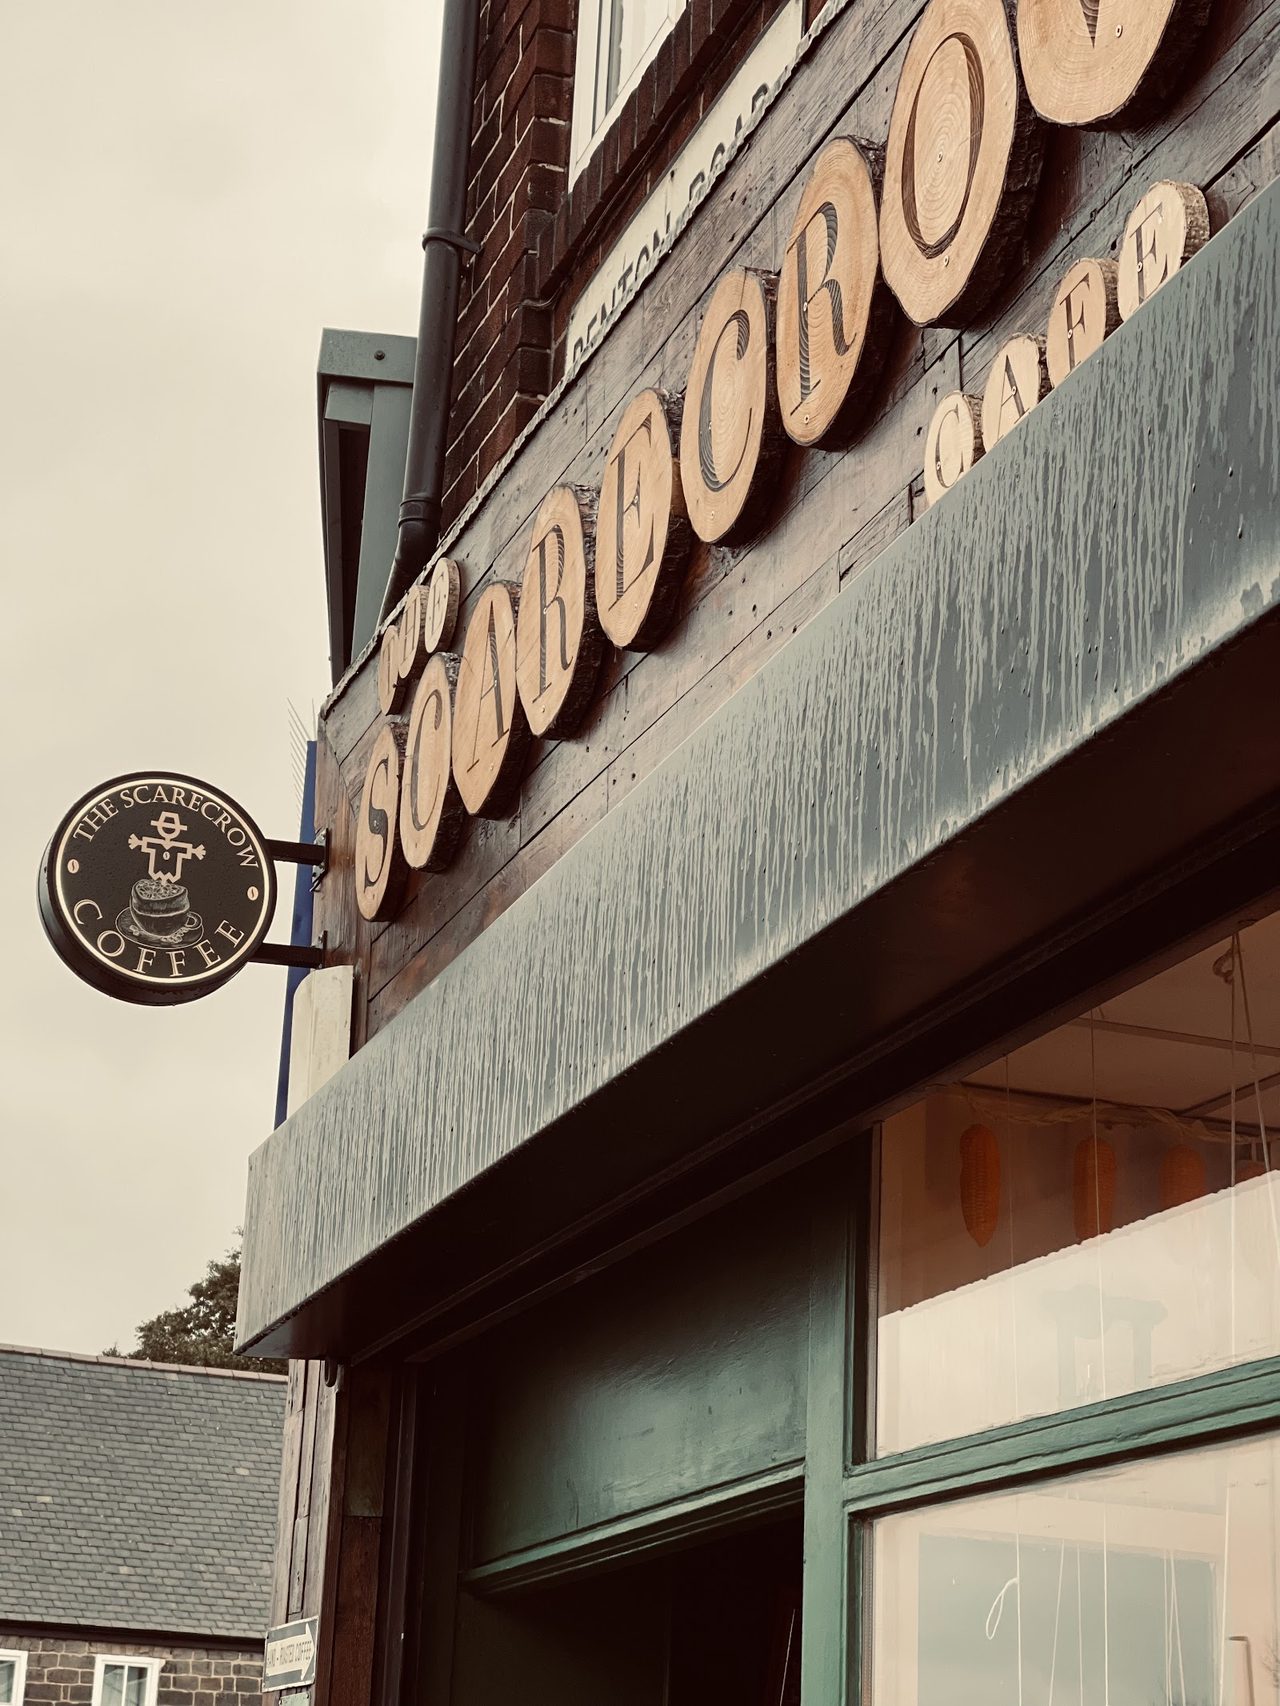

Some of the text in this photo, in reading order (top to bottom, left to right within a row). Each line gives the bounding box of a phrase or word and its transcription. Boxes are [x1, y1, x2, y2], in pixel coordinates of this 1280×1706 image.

[935, 201, 1168, 489] CAFE
[363, 0, 1100, 893] SCARECRO
[382, 569, 447, 697] THE
[73, 784, 259, 869] THE SCARECROW
[73, 899, 246, 977] COFFEE
